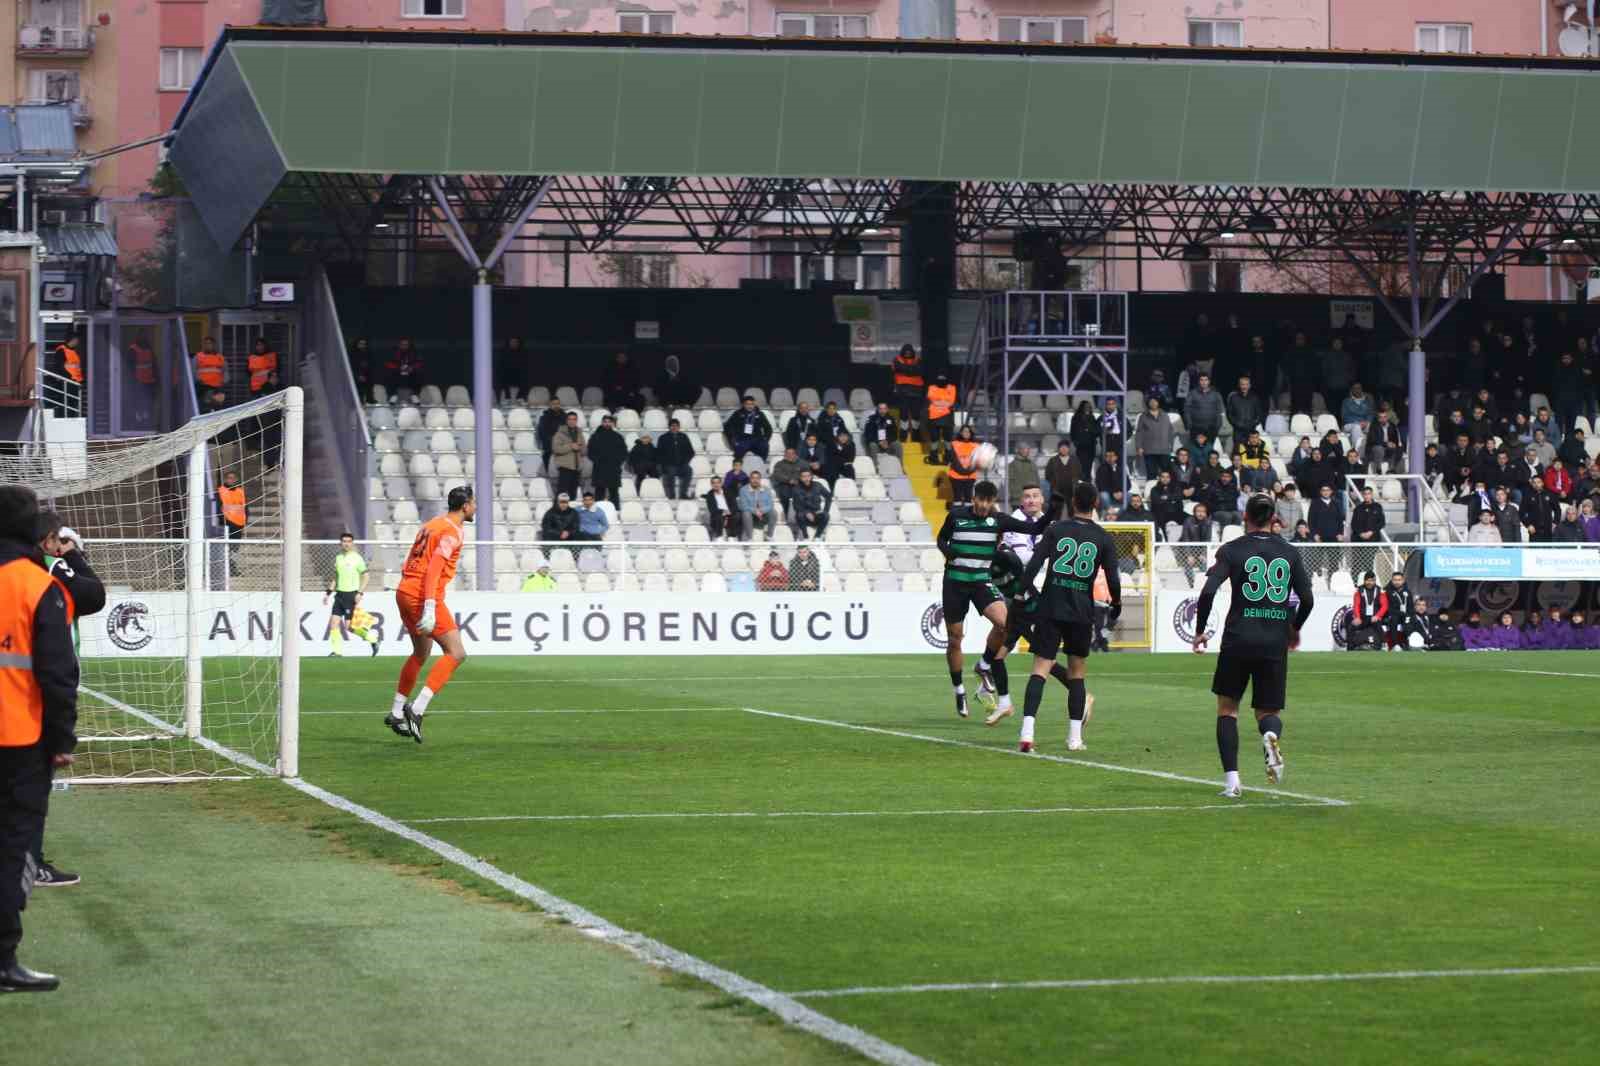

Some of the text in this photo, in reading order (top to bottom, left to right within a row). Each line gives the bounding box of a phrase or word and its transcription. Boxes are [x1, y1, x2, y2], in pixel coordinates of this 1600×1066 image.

[1053, 537, 1098, 577] 28
[1242, 556, 1290, 602] 39
[454, 604, 870, 652] KEÇİÖRENGÜCÜ
